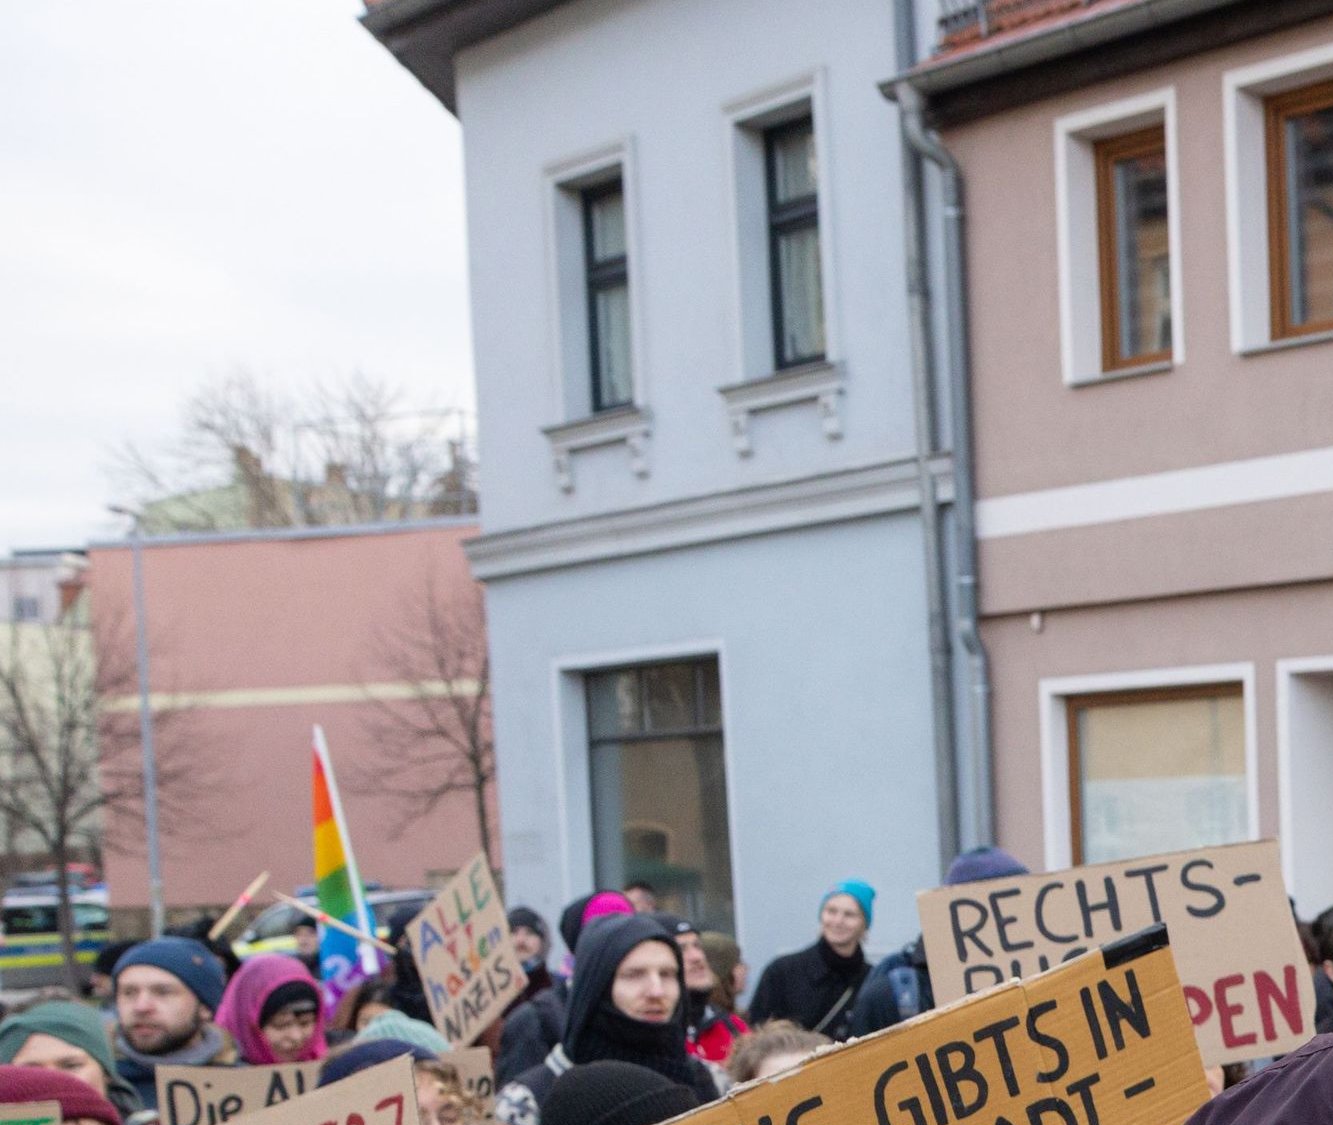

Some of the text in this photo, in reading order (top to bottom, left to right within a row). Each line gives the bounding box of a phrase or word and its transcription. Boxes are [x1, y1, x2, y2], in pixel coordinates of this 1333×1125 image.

[420, 862, 491, 964] ALLE
[949, 859, 1261, 962] RECHTS-
[444, 957, 512, 1042] NAZIS
[1080, 969, 1150, 1060] IN
[1182, 965, 1303, 1048] PEN
